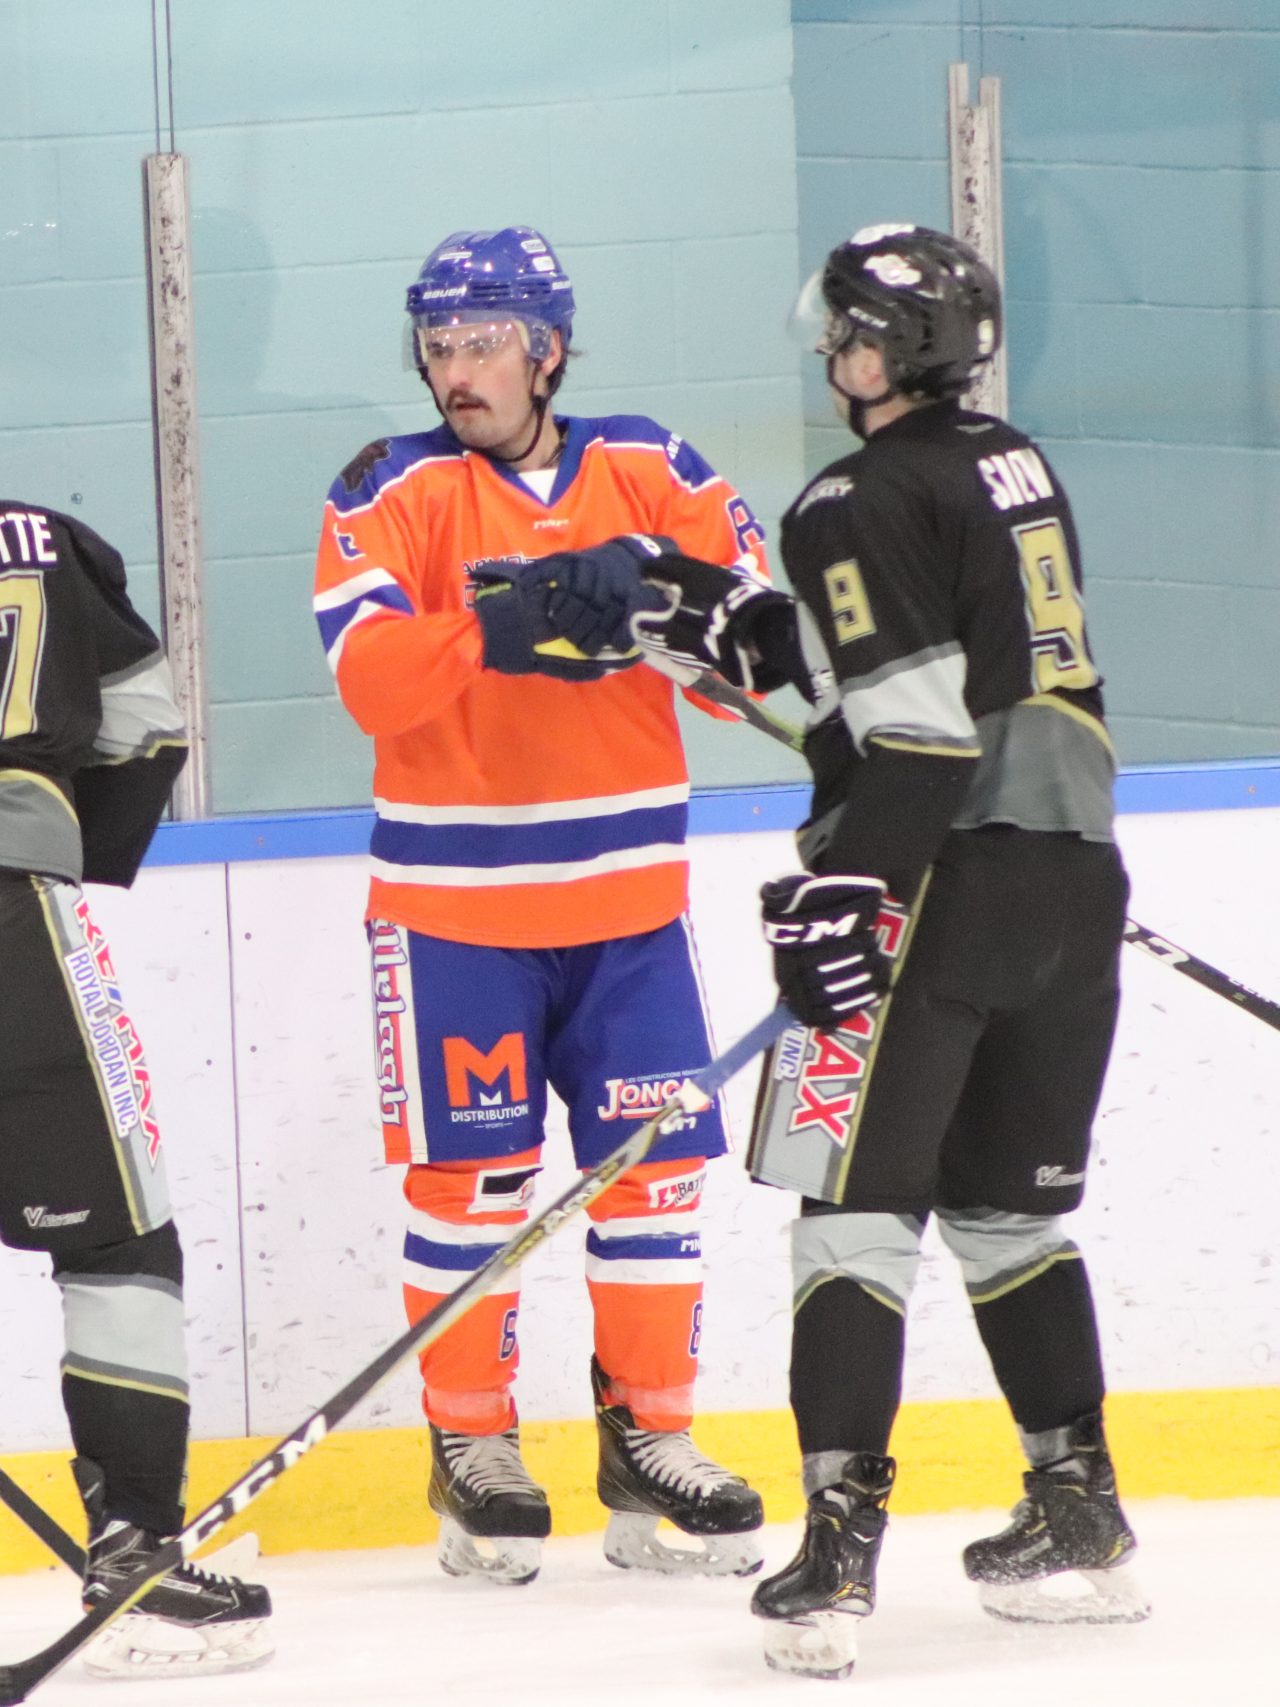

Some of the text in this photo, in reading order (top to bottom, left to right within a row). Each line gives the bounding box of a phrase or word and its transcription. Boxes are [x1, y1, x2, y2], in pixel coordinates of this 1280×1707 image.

[825, 558, 877, 647] 9
[1011, 516, 1106, 696] 9
[68, 950, 107, 1017] ROYAL
[90, 1011, 129, 1089] JORDAN
[451, 1104, 529, 1123] DISTRIBUTION
[175, 1412, 327, 1558] CCM
